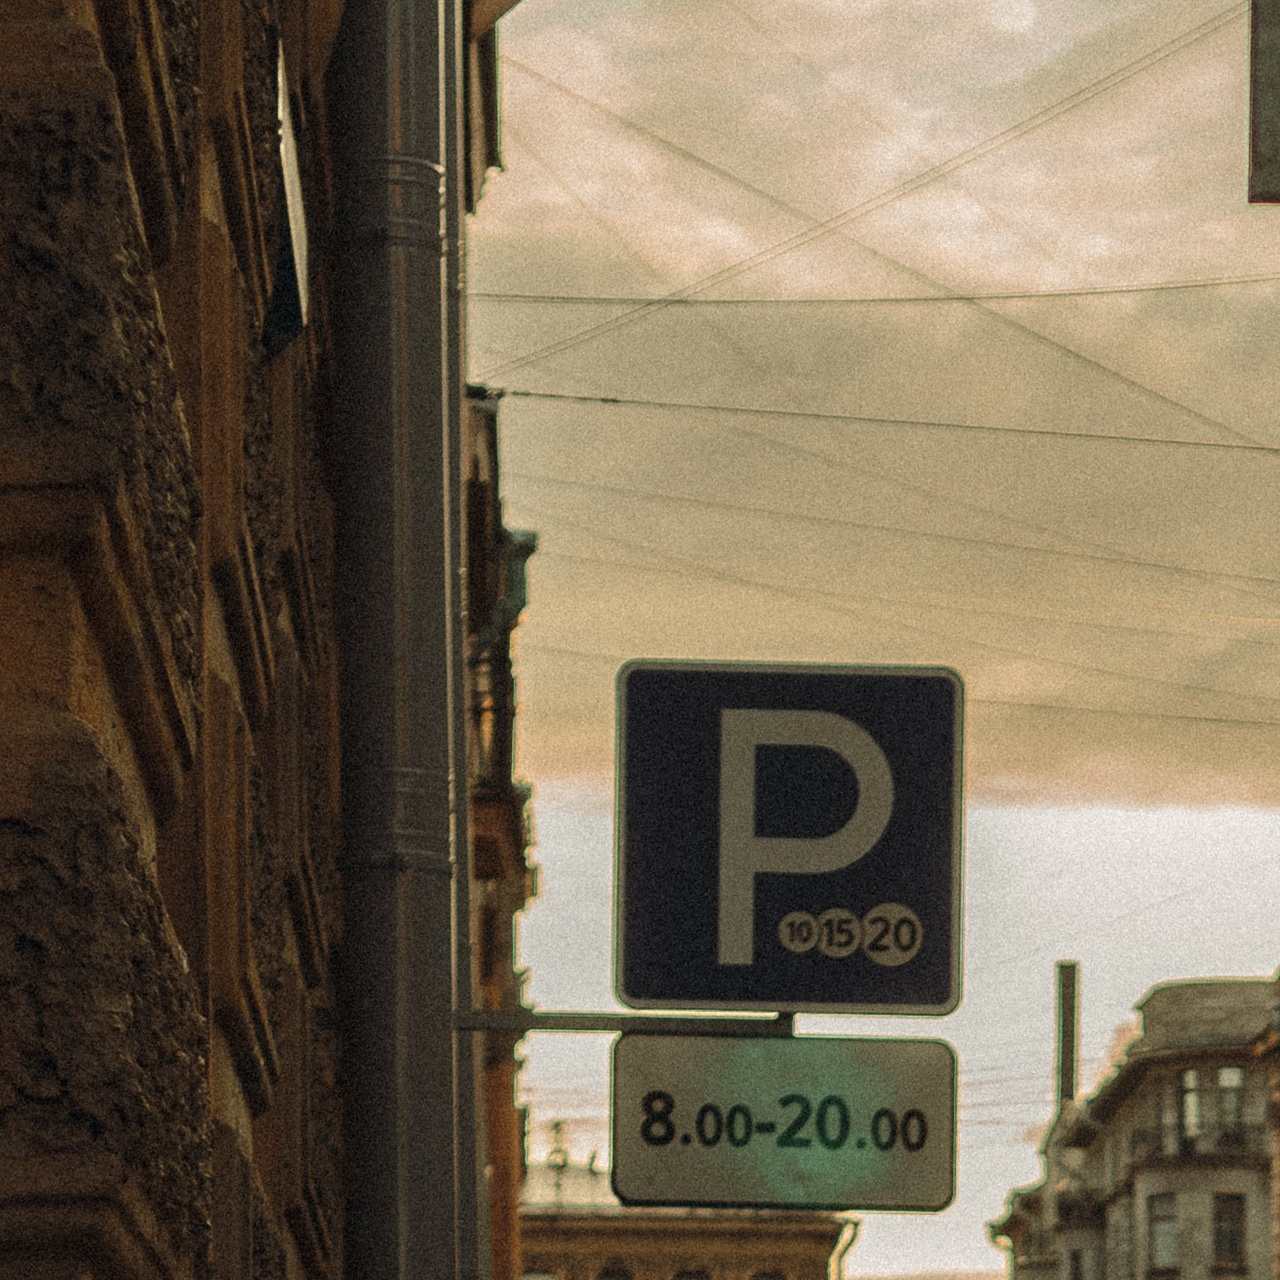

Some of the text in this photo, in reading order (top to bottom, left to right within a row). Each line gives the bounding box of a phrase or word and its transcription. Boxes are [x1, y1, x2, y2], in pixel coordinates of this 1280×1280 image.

[717, 708, 895, 966] P
[785, 916, 917, 952] 10 15 20
[641, 1090, 928, 1151] 8.00-20.00
